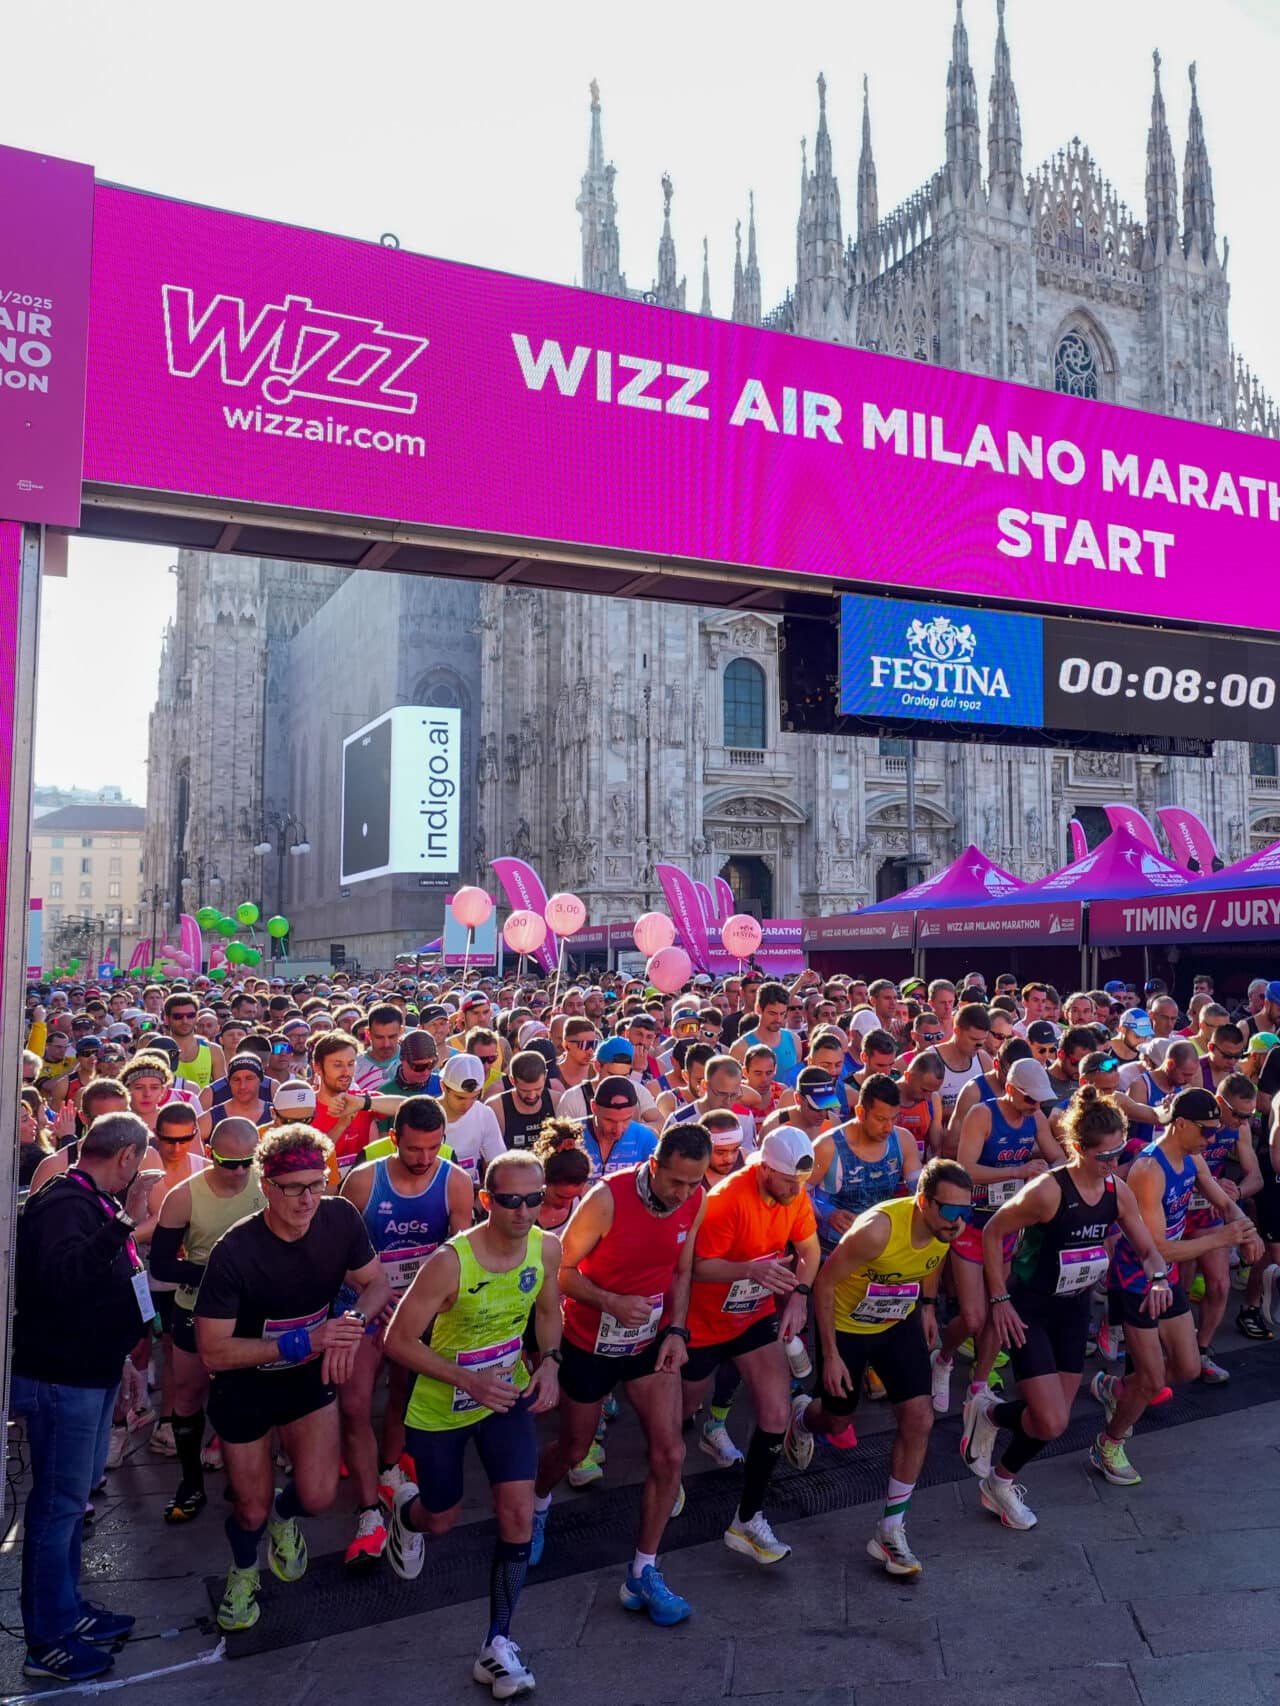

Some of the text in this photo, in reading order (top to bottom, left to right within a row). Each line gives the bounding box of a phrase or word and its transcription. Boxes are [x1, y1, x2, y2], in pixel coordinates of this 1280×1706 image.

[222, 405, 426, 457] wizzair.com
[511, 333, 710, 420] WIZZ
[729, 378, 843, 445] AIR
[861, 402, 1086, 486] MILANO
[996, 507, 1175, 578] START
[869, 655, 1011, 698] FESTINA
[1058, 657, 1277, 710] 00:08:00
[901, 692, 981, 711] Orologi dal 1902
[420, 719, 455, 859] indigo.ai
[975, 920, 1000, 931] MILANO
[1001, 919, 1040, 930] MARATHON
[1122, 903, 1198, 932] TIMING
[384, 1219, 429, 1235] Agos
